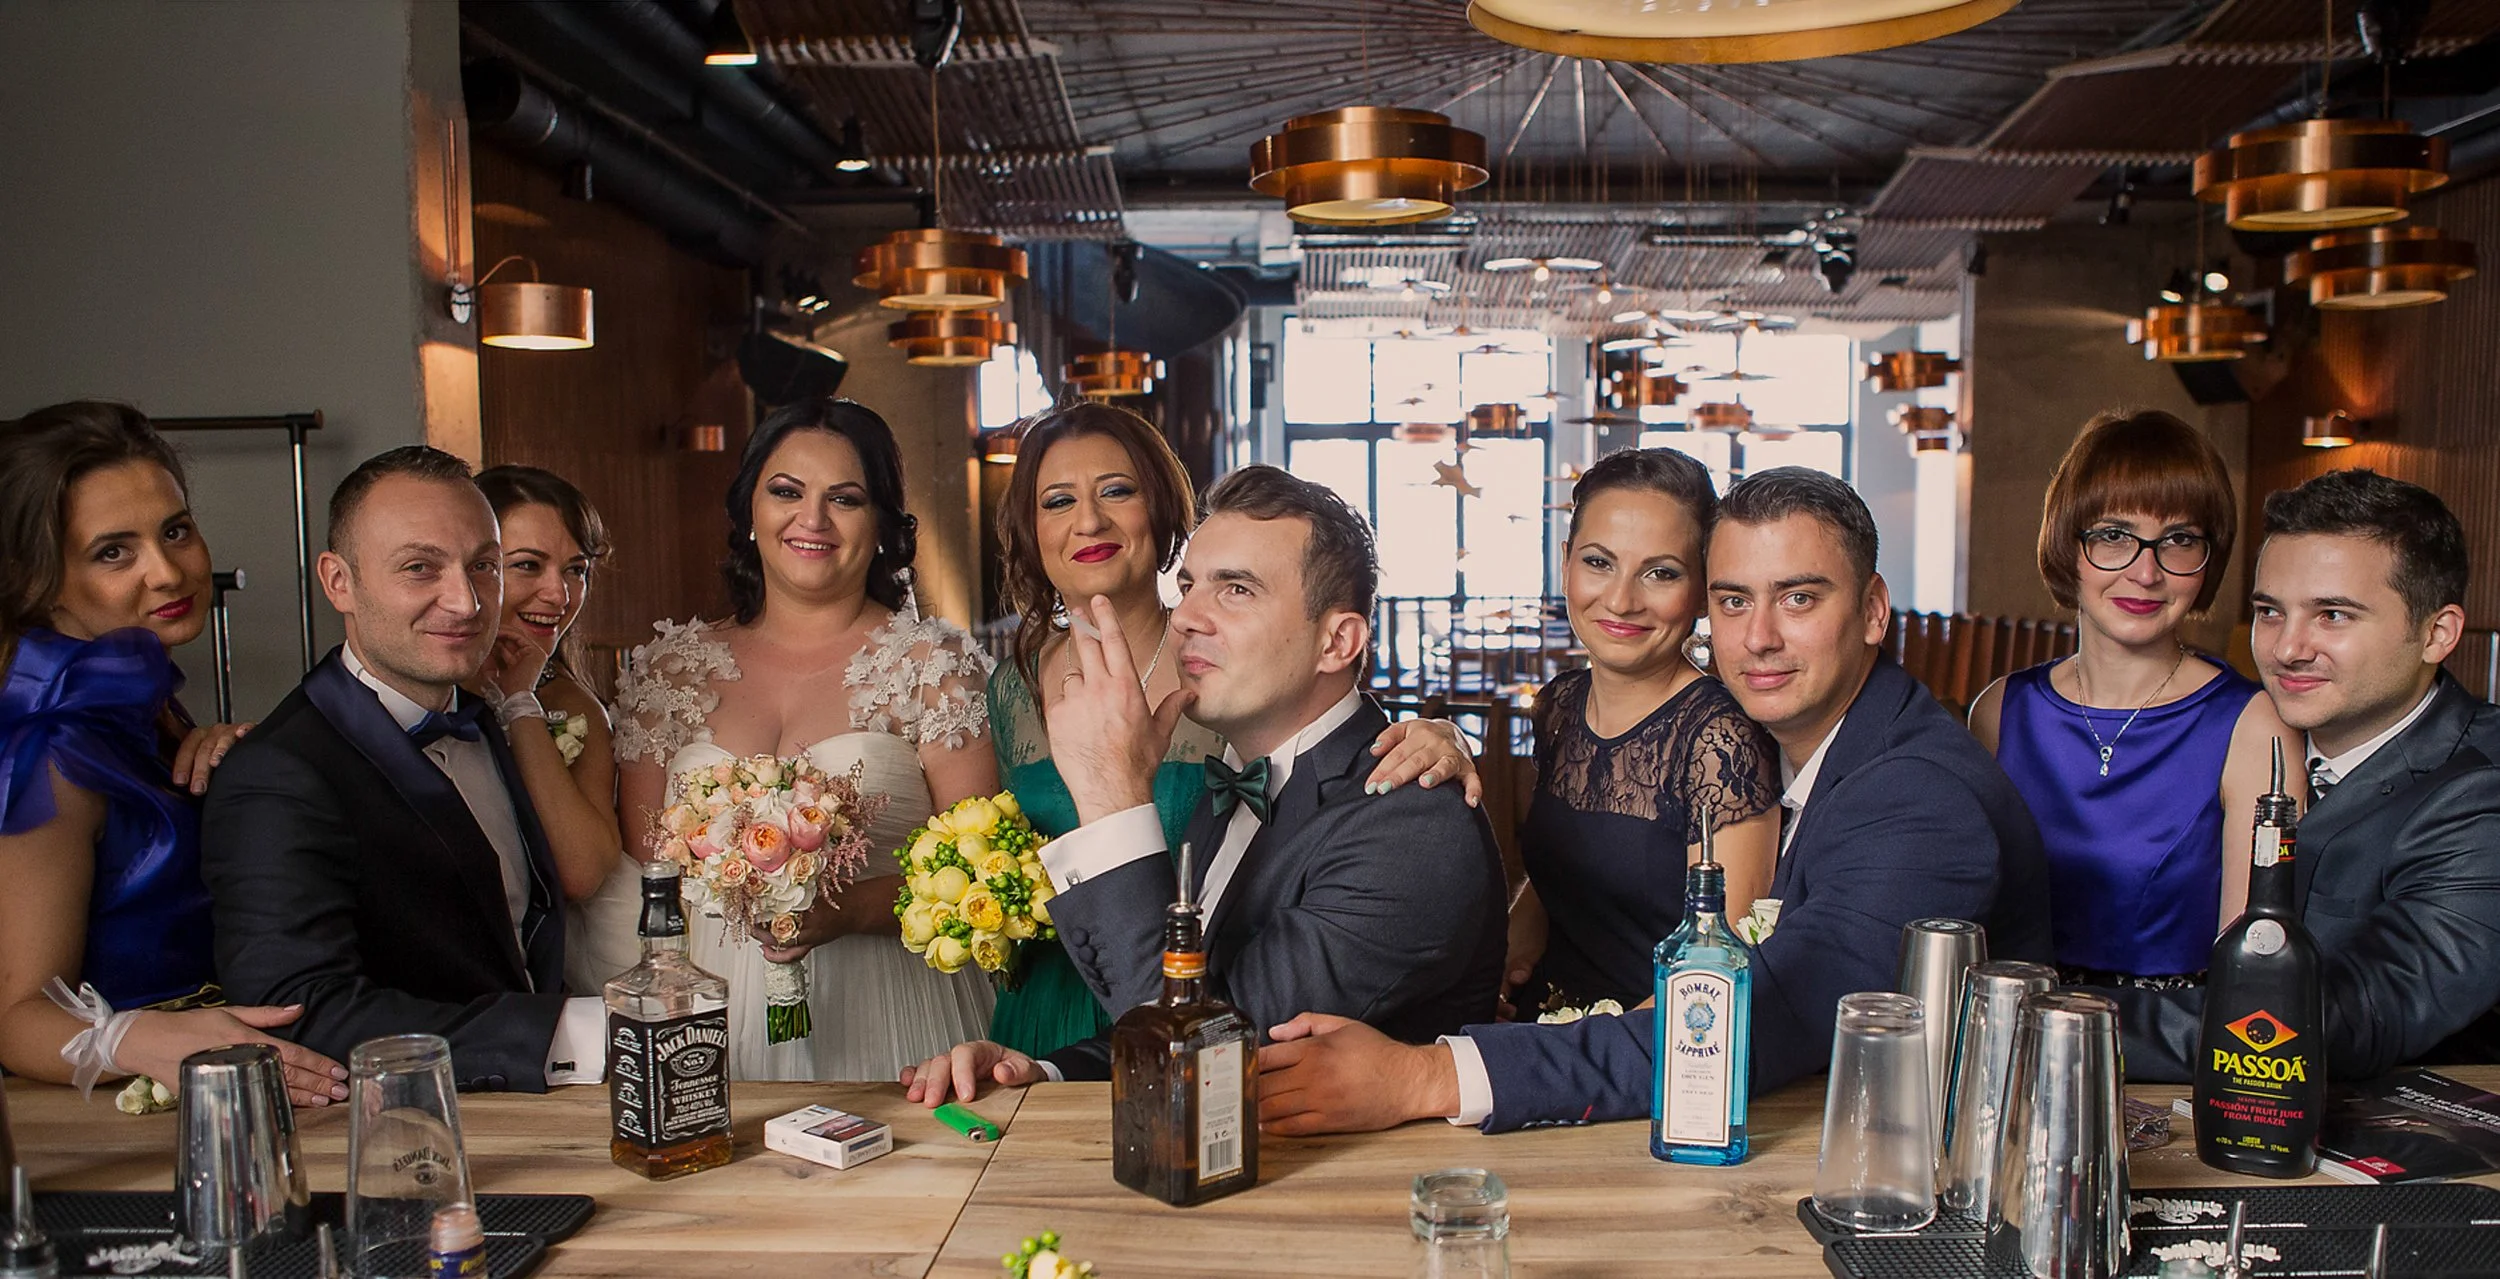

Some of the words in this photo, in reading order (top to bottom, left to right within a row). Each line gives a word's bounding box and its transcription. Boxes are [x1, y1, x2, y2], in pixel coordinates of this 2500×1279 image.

[1679, 983, 1722, 1002] BOMBAY
[655, 1033, 687, 1061] JACK
[686, 1026, 729, 1048] DANIEL'S
[1675, 1040, 1721, 1058] SAPPHIRE
[2213, 1048, 2306, 1082] PASSOÃ
[671, 1074, 719, 1091] Tennessee
[2232, 1077, 2242, 1085] THE
[672, 1087, 719, 1105] WHISKEY
[2223, 1111, 2251, 1121] FROM
[2253, 1115, 2287, 1127] BRAZIL
[2250, 1105, 2278, 1116] FRUIT
